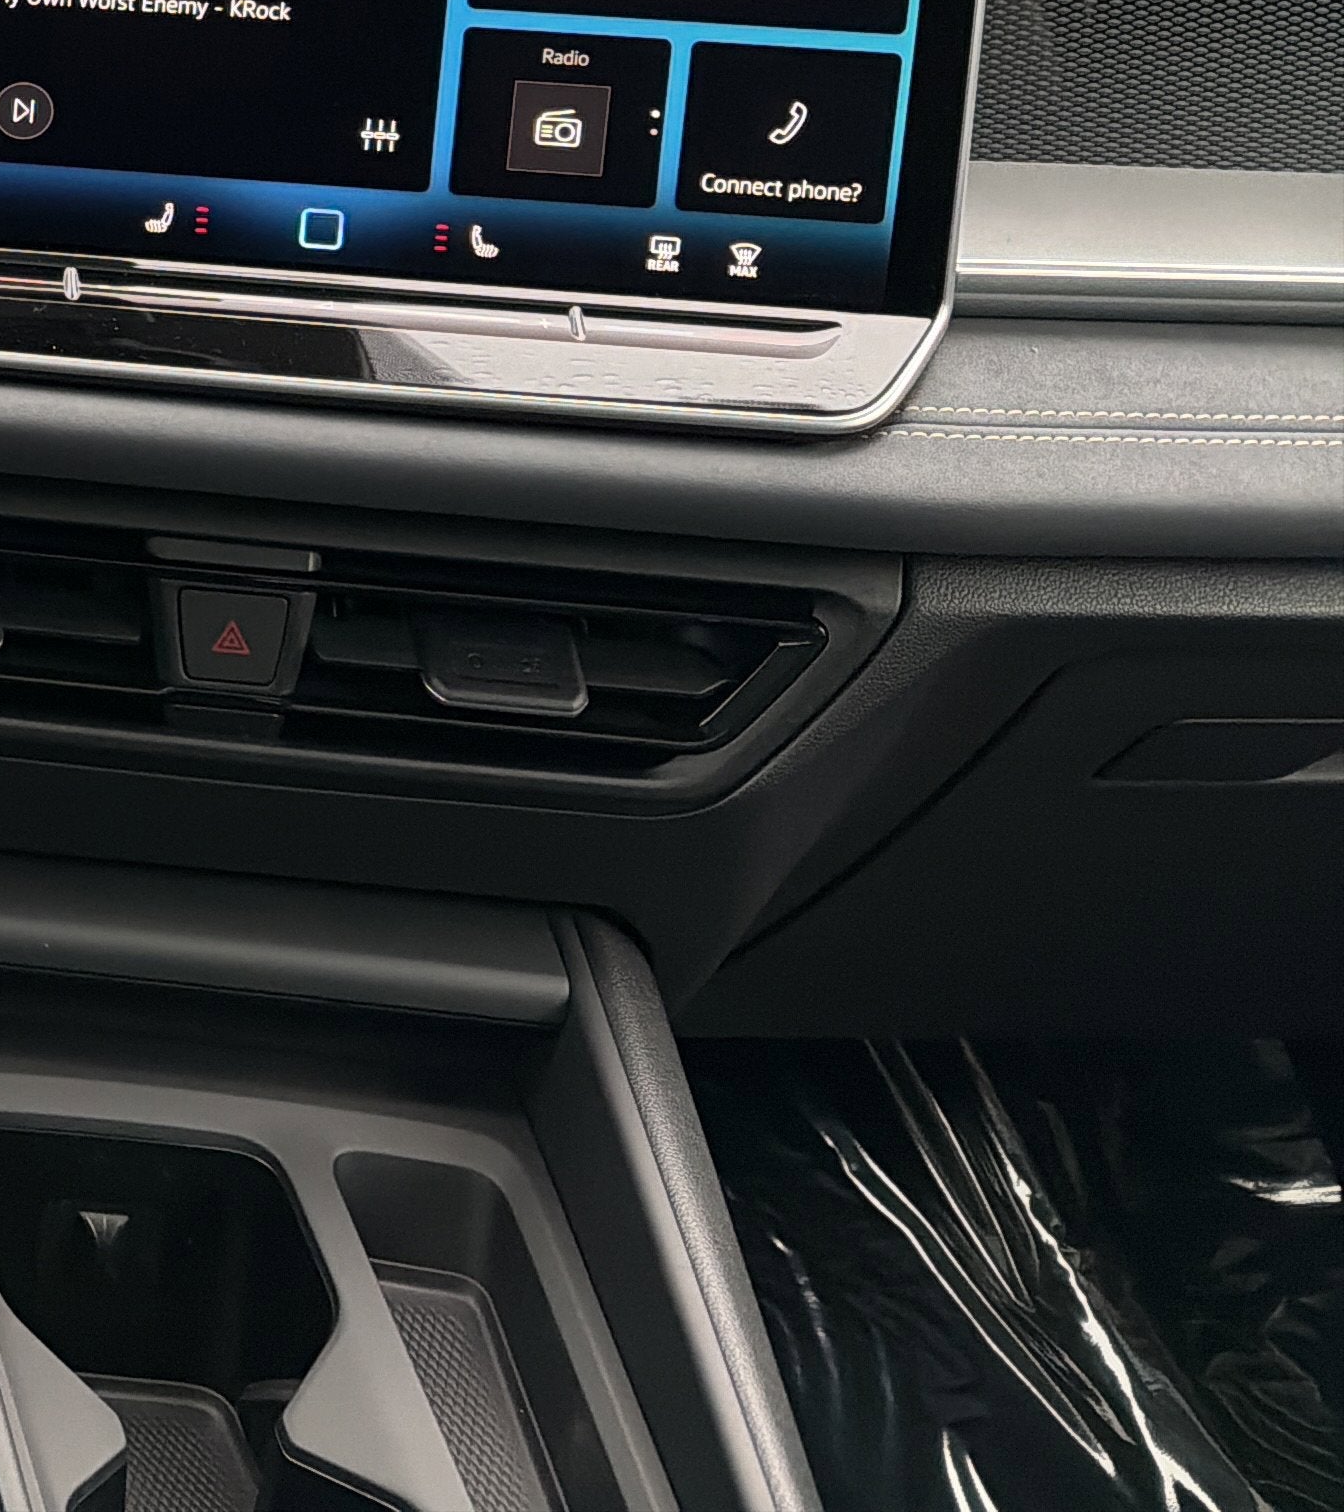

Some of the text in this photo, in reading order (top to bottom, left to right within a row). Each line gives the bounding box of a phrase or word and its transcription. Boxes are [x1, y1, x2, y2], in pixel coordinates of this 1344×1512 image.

[541, 47, 590, 67] Radio
[700, 172, 863, 204] Connect phone?
[646, 258, 680, 273] REAR
[728, 264, 759, 279] MAX
